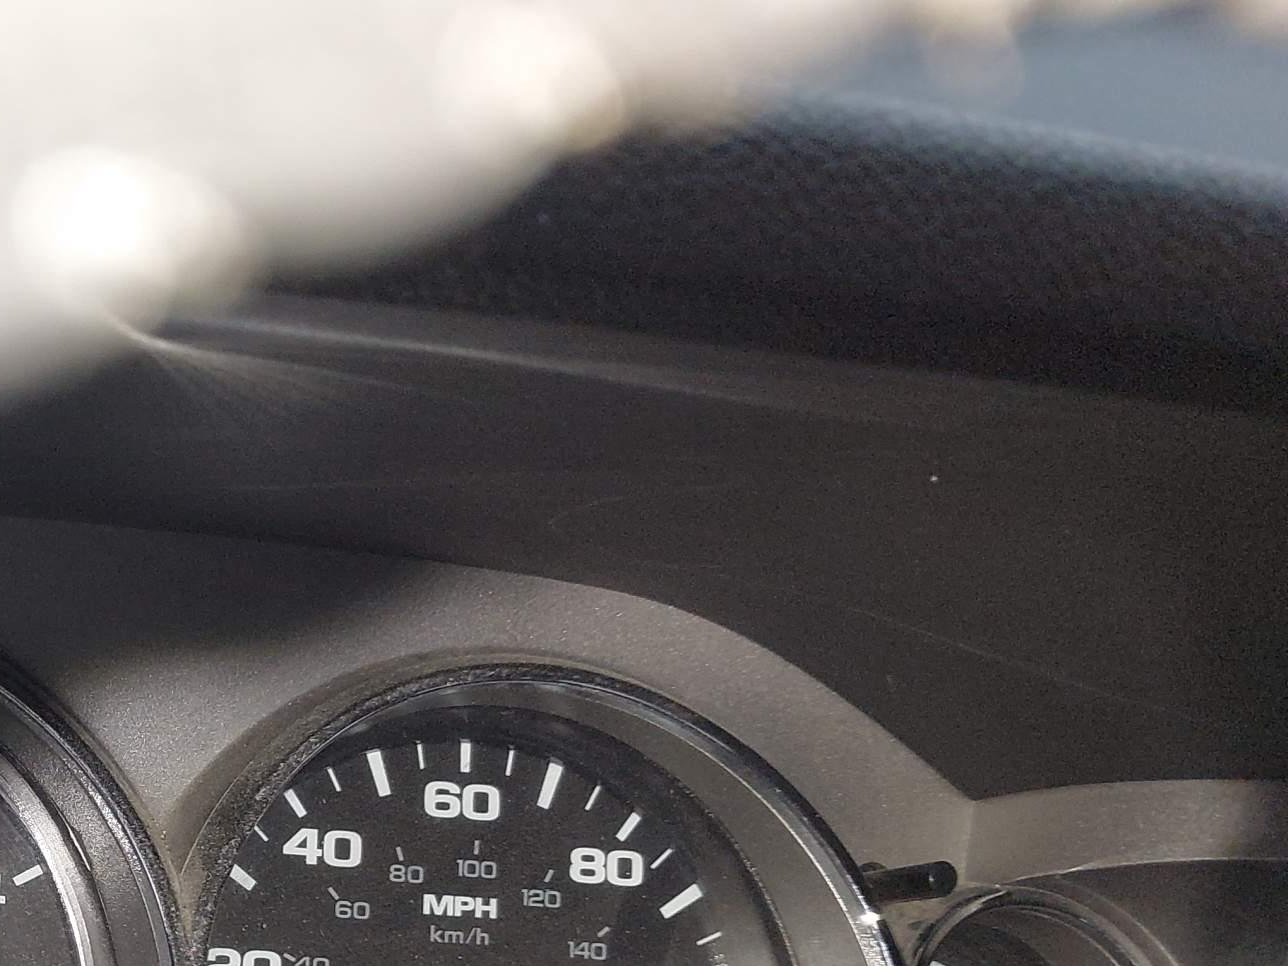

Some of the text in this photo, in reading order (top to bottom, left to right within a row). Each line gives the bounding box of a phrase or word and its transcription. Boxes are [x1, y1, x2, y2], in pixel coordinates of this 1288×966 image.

[423, 780, 501, 822] 60
[282, 828, 362, 868] 40
[389, 863, 425, 885] 80
[456, 858, 497, 880] 100
[568, 846, 643, 887] 80
[422, 893, 498, 920] MPH
[521, 887, 562, 910] 120
[334, 900, 371, 921] 60
[429, 926, 490, 946] km/h
[568, 939, 608, 961] 140
